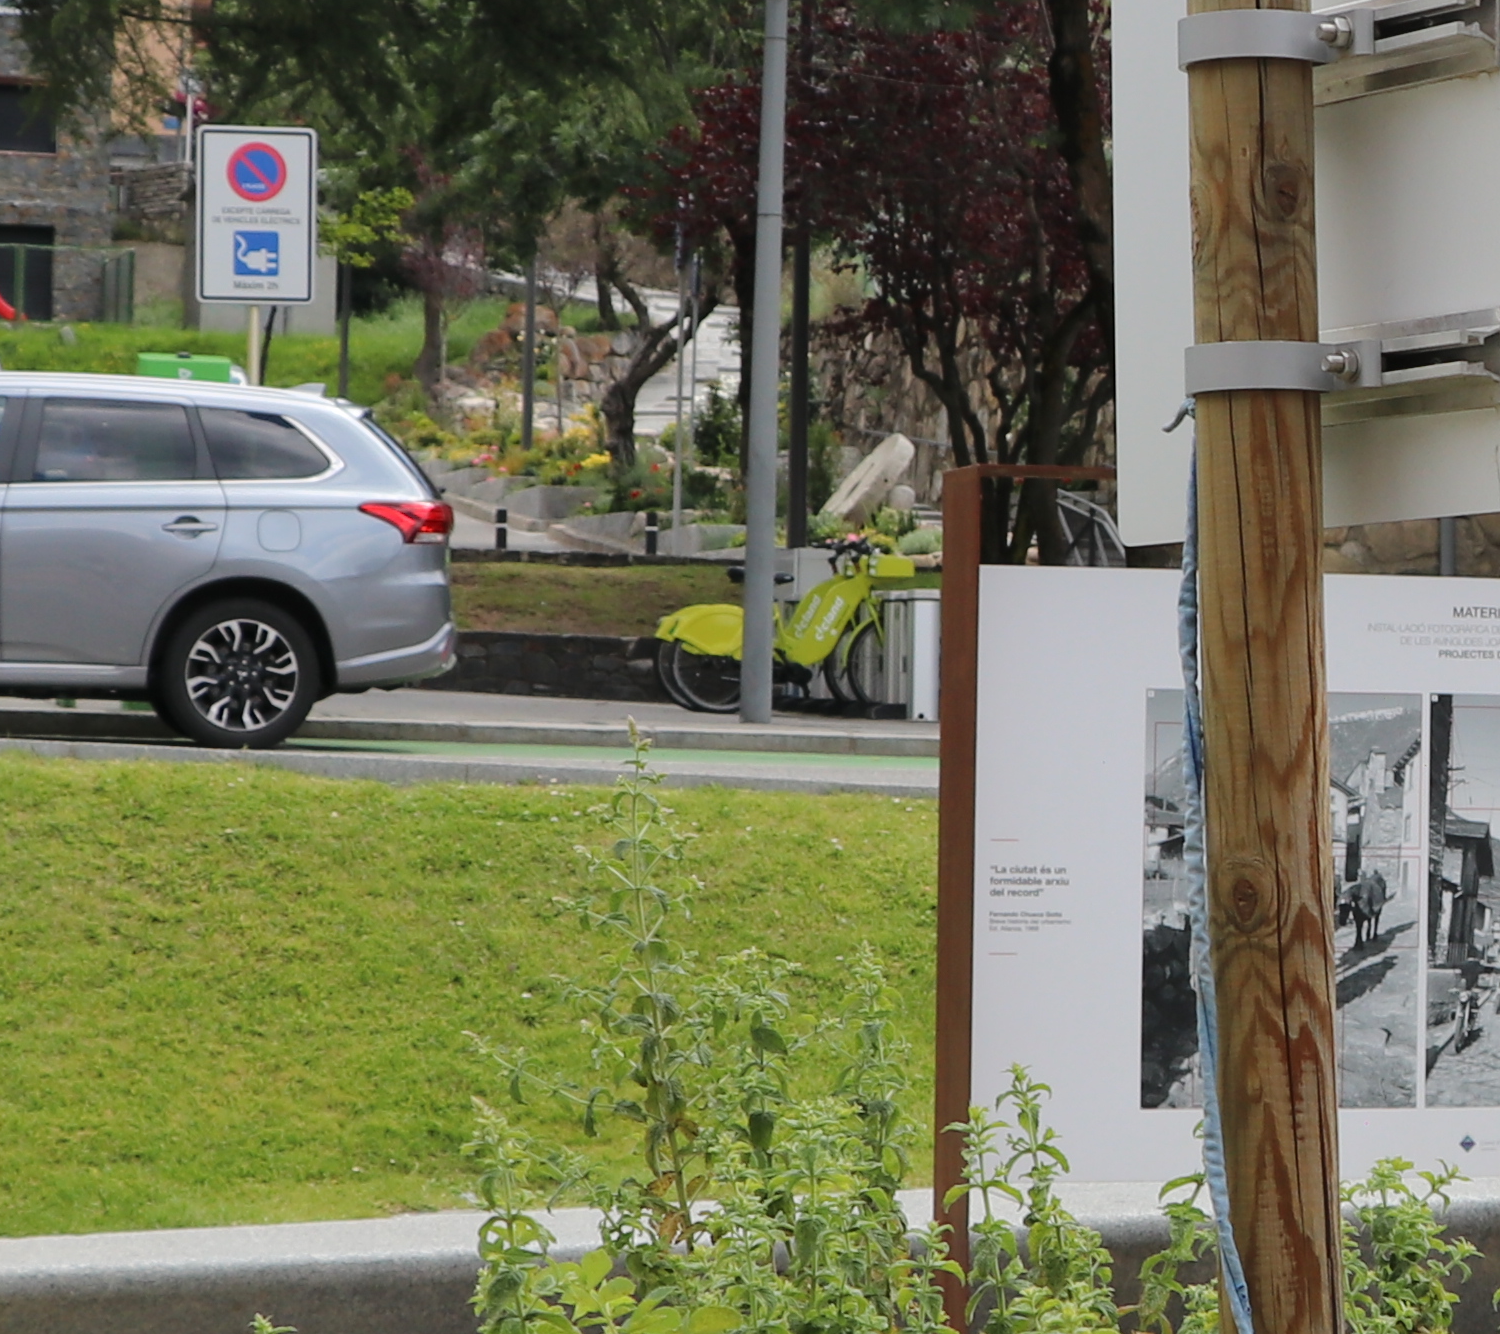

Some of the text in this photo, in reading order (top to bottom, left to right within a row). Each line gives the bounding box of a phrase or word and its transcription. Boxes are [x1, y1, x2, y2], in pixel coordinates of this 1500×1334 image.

[1400, 635, 1412, 645] DE
[1414, 636, 1431, 646] LES
[1438, 649, 1495, 660] PROJECTES
[1009, 865, 1037, 874] ciutat
[1054, 867, 1067, 875] un
[989, 876, 1070, 886] formidable arxiu
[989, 888, 1005, 897] del
